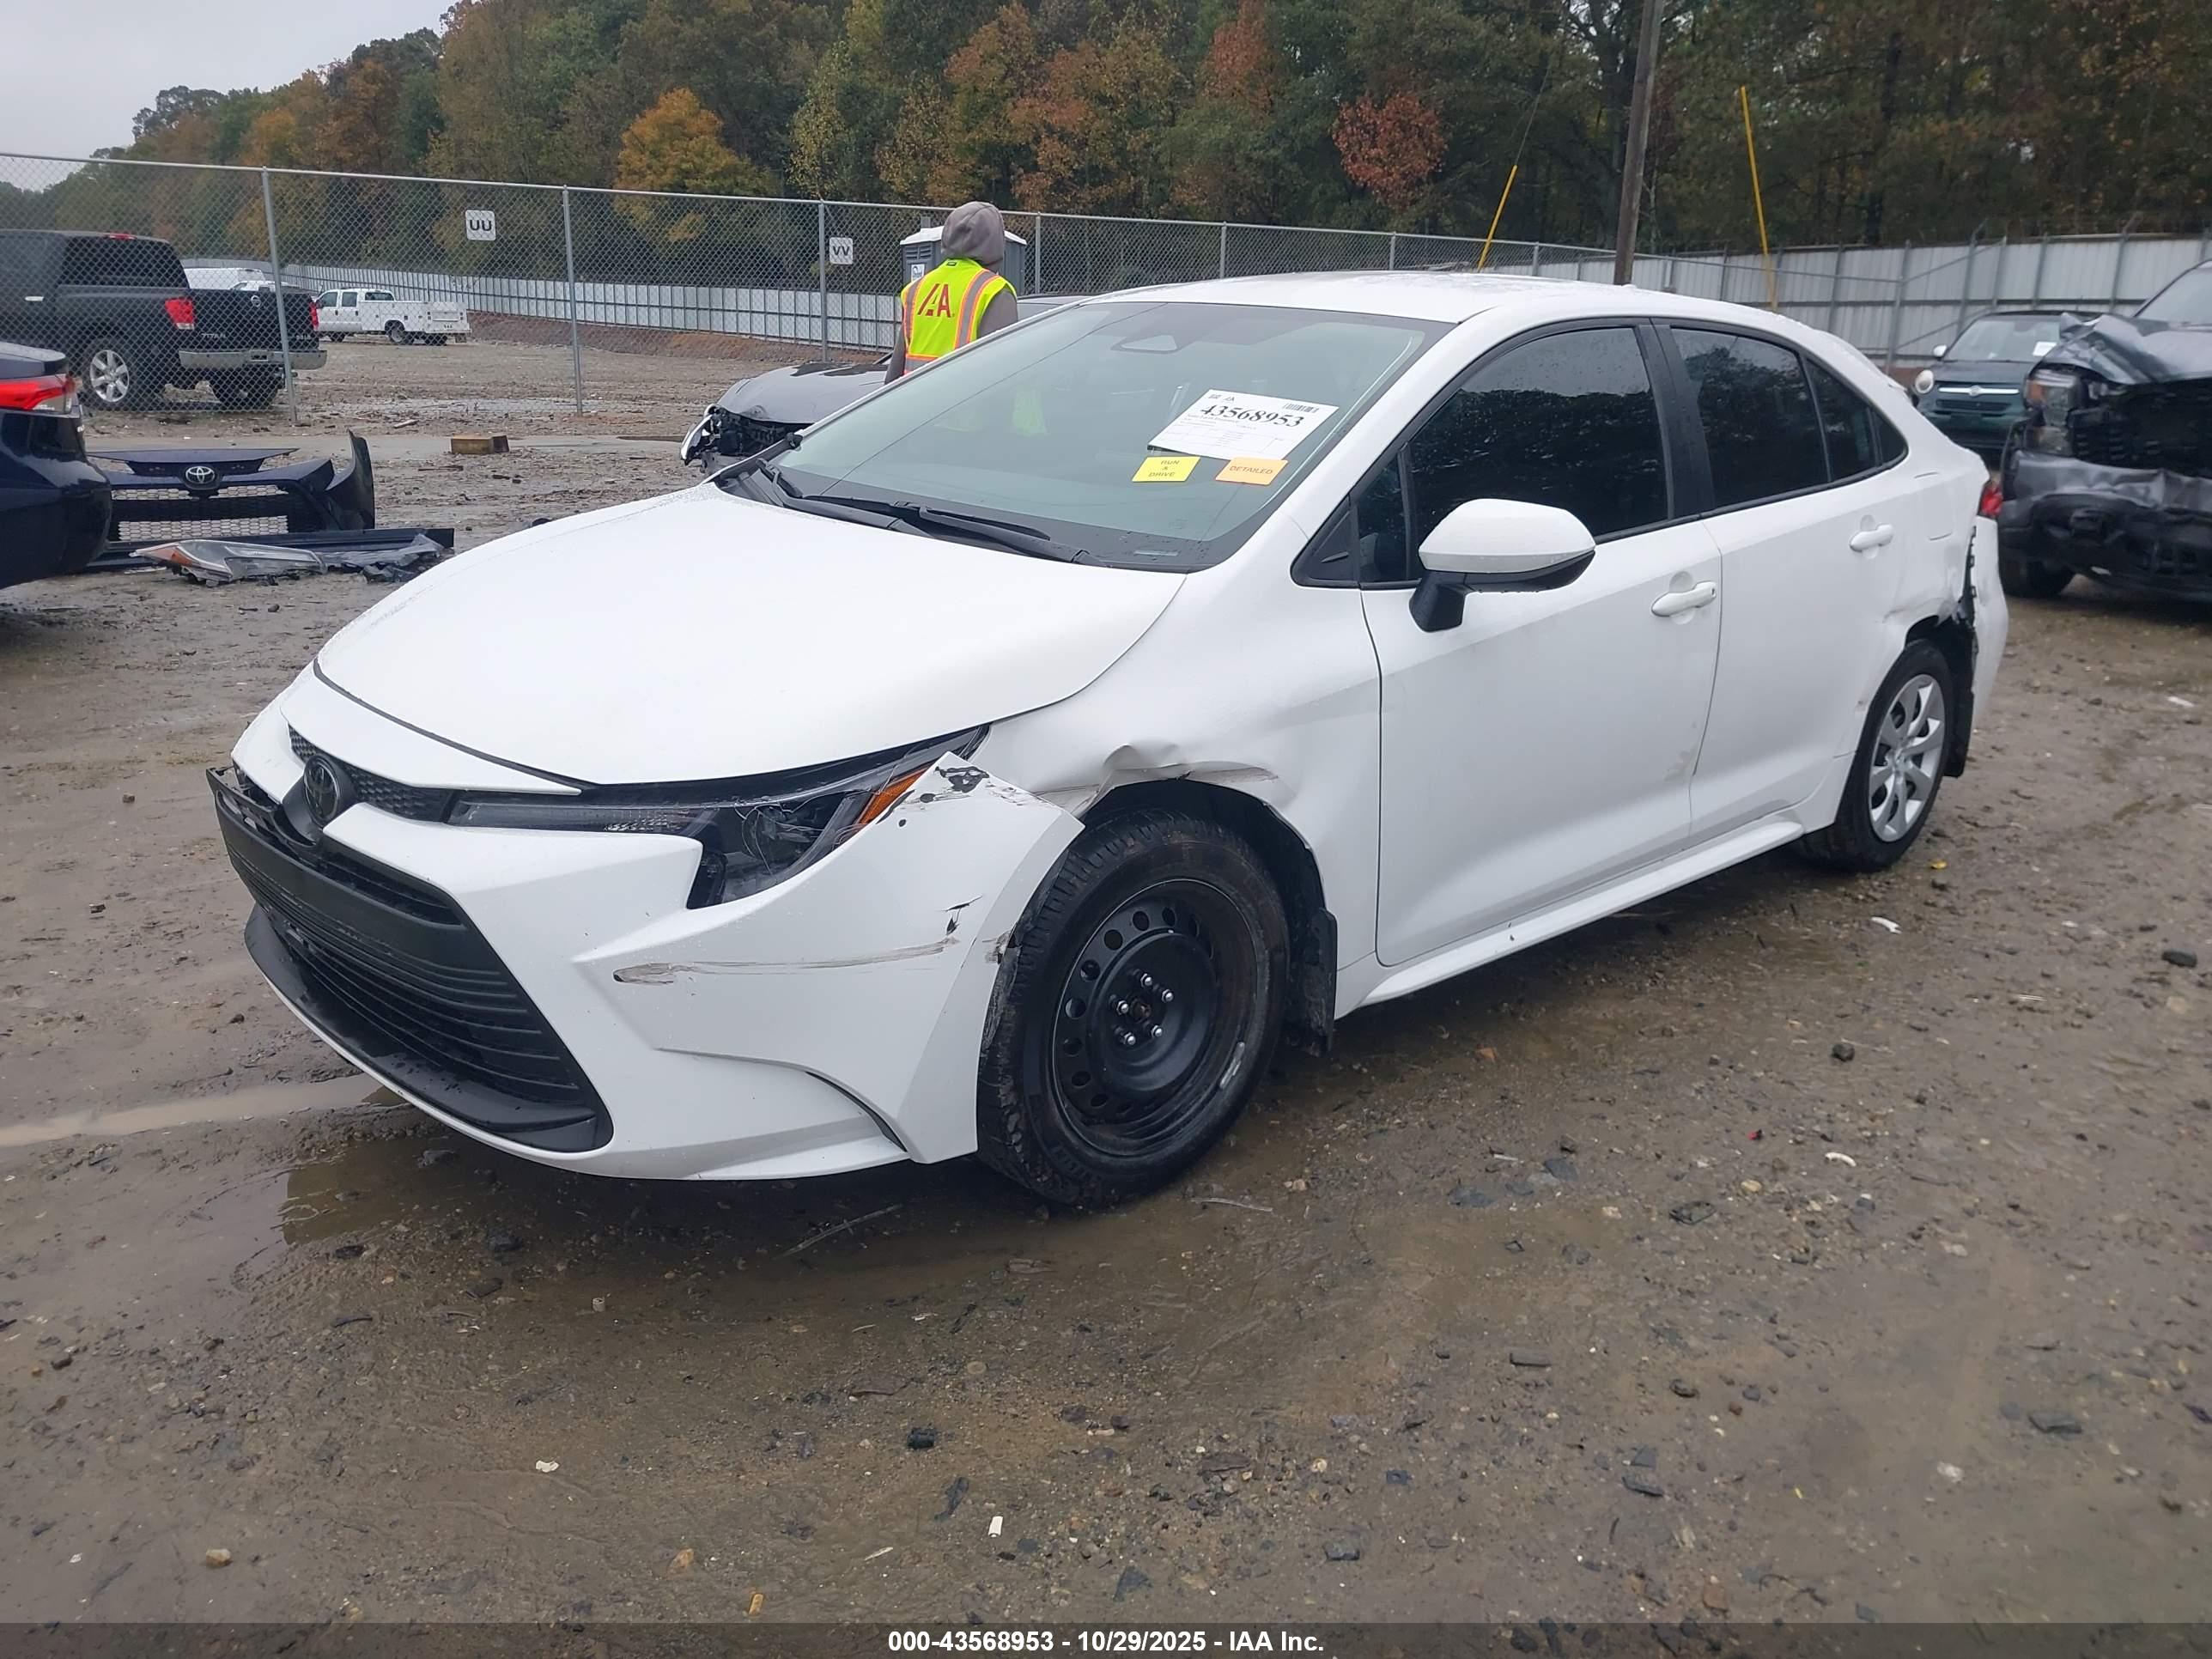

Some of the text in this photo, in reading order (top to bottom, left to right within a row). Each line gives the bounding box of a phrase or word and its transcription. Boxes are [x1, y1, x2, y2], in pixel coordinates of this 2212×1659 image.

[469, 219, 492, 231] UU
[832, 246, 850, 256] VV
[1201, 404, 1304, 427] 43568953
[1229, 465, 1273, 475] DETAILED
